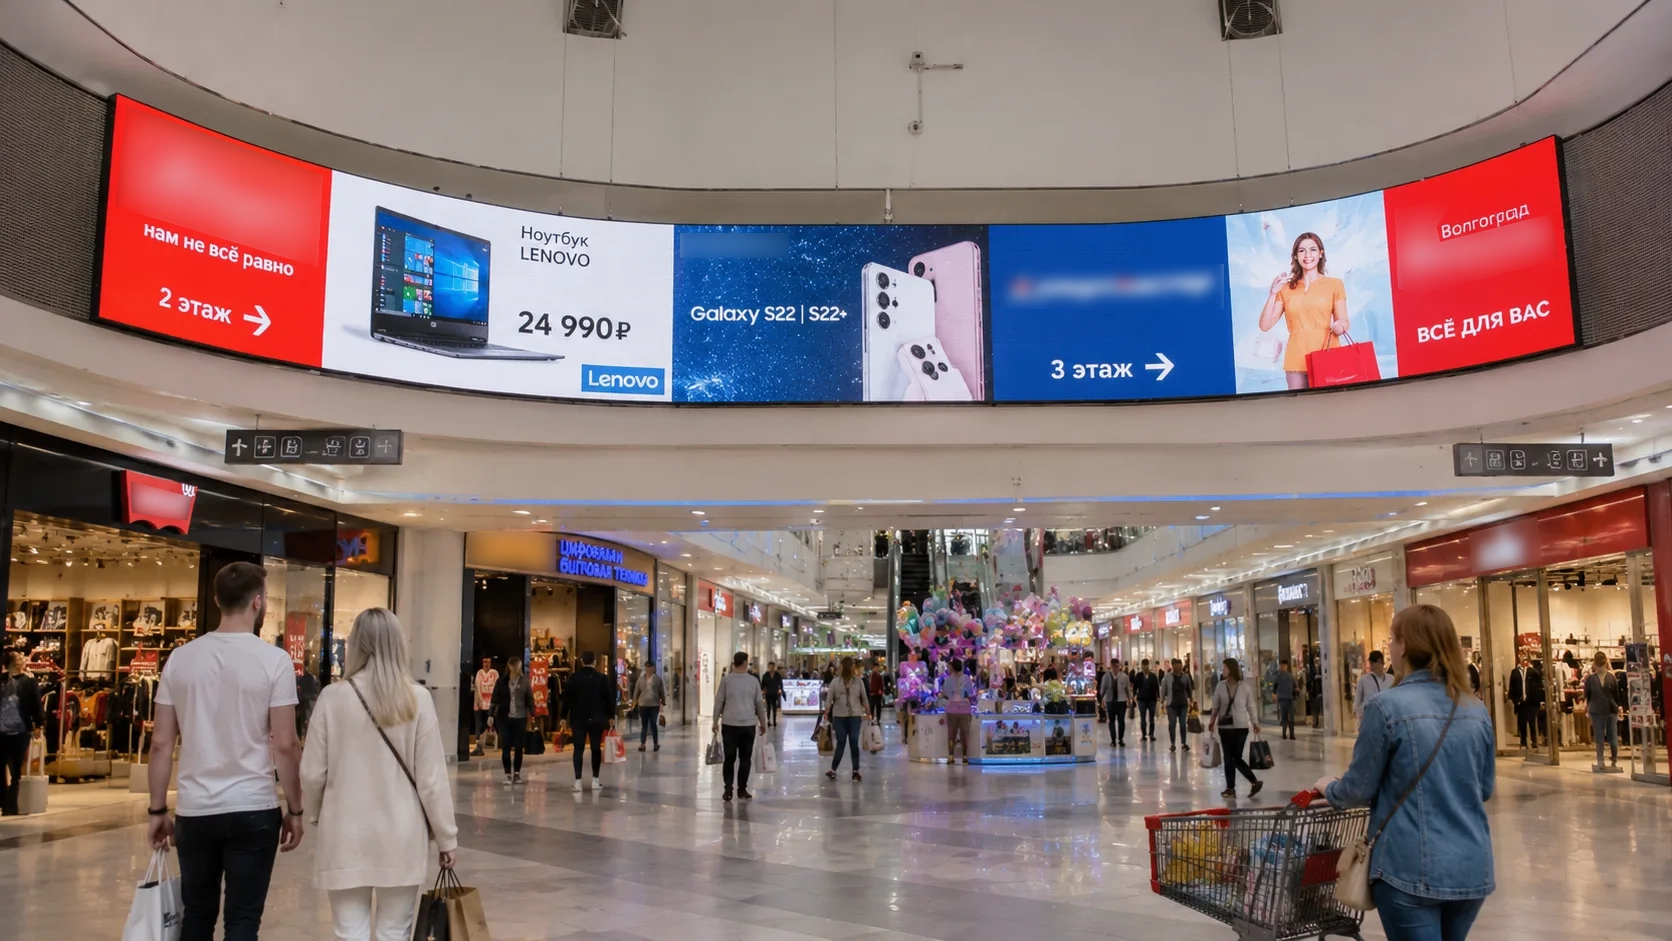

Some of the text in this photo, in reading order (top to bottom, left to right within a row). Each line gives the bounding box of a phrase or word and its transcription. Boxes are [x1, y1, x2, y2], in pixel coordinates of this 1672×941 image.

[1440, 204, 1530, 239] Волгоград
[143, 223, 294, 276] нам не всё равно
[521, 225, 589, 249] Ноутбук
[520, 246, 591, 268] LENOVO
[158, 286, 232, 325] 2 этаж
[690, 305, 760, 325] Galaxy
[764, 306, 796, 322] S22
[808, 306, 848, 322] S22+
[518, 310, 552, 336] 24
[1417, 300, 1550, 343] ВСЁ ДЛЯ ВАС
[588, 369, 659, 389] Lenovo
[1050, 359, 1133, 380] 3 этаж
